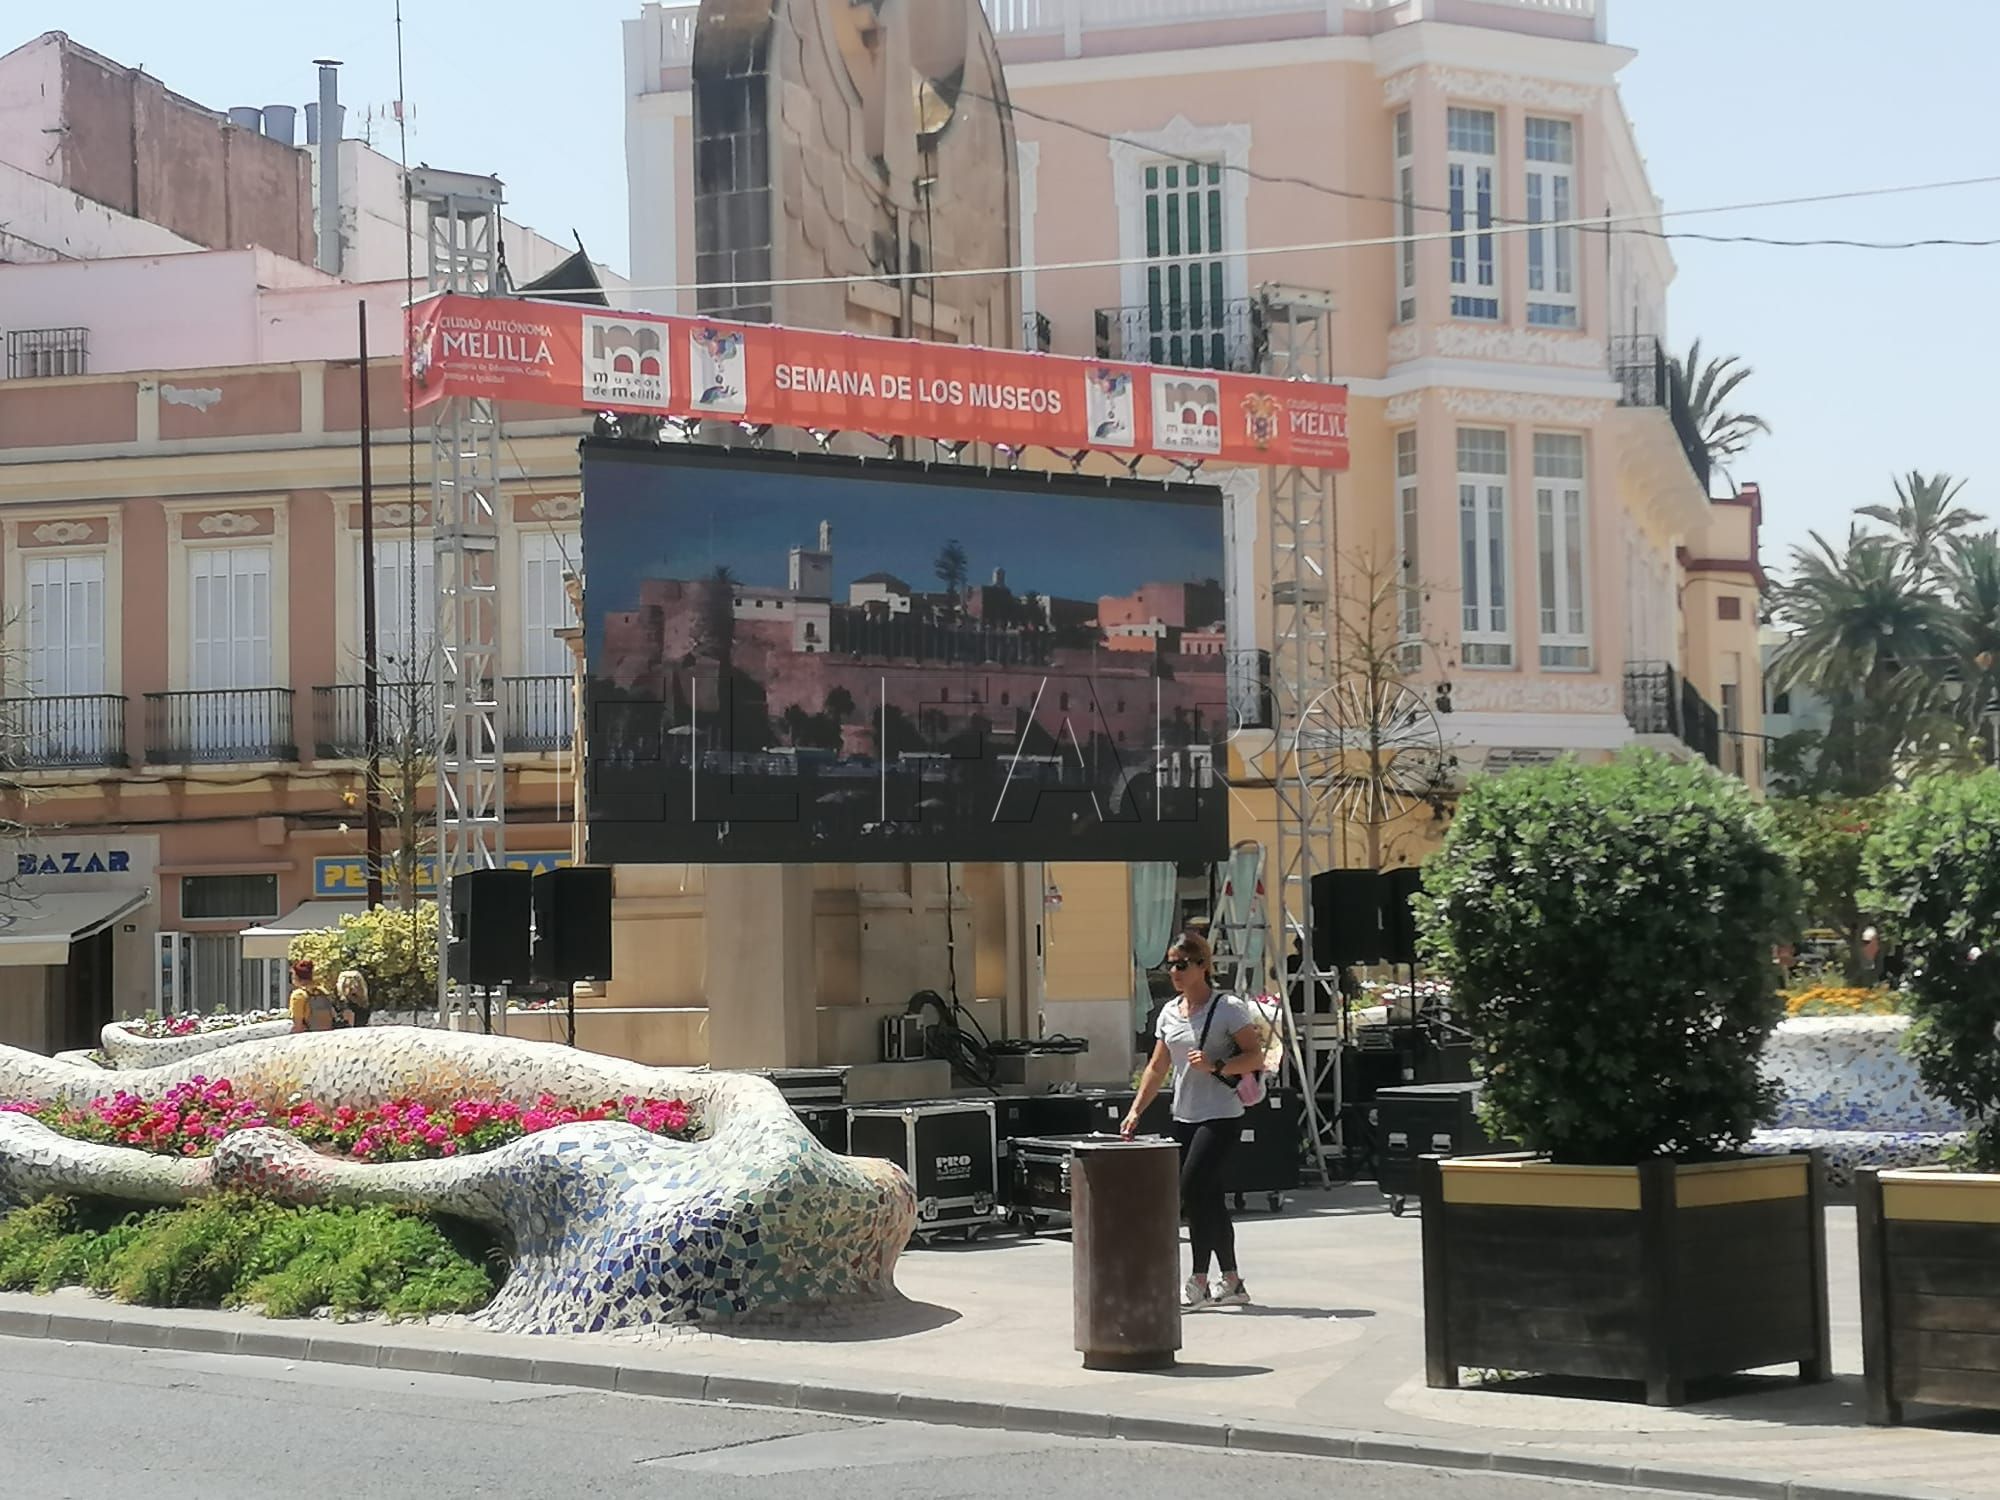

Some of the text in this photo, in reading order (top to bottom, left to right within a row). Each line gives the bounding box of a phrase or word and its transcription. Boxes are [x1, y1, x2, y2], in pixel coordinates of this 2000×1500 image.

[439, 317, 553, 337] CIUDAD AUTÓNOMA
[442, 331, 555, 366] MELILLA
[775, 363, 1062, 415] SEMANA DE LOS MUSEOS
[17, 850, 131, 875] BAZAR
[935, 1155, 972, 1169] PRO
